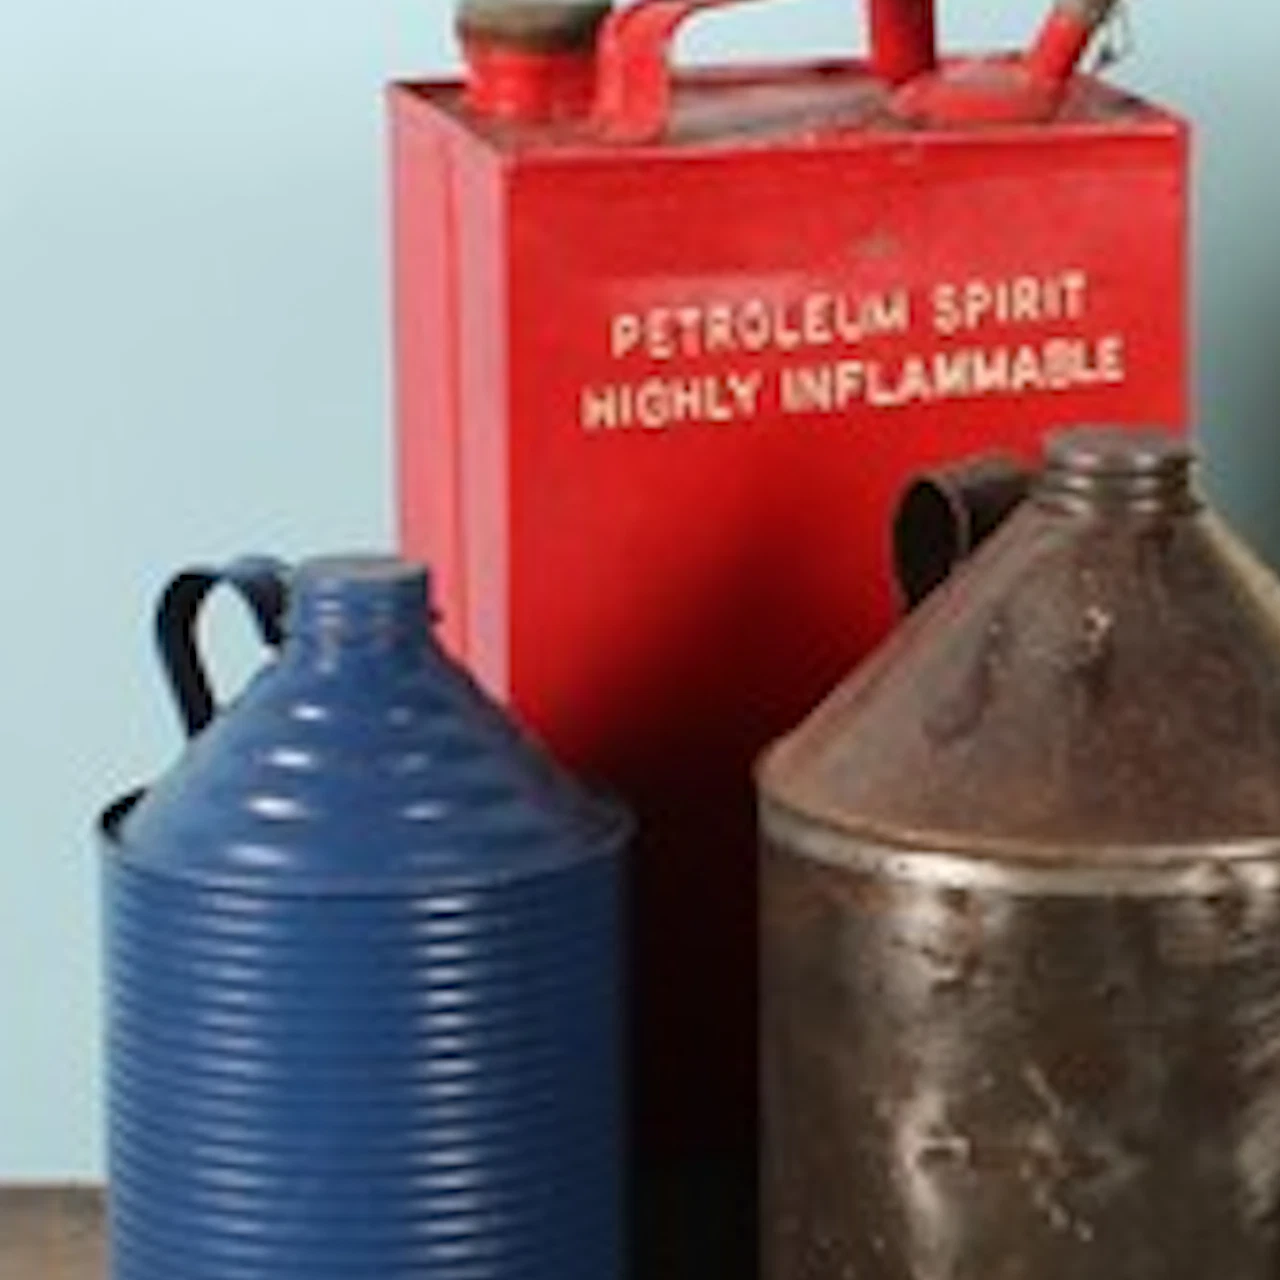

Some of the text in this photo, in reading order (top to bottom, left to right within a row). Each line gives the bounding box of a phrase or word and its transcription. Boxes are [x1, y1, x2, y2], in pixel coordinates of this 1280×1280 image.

[610, 270, 1088, 358] PETROLEUM SPIRIT
[583, 336, 1125, 429] HIGHLY INFLAMMABLE
